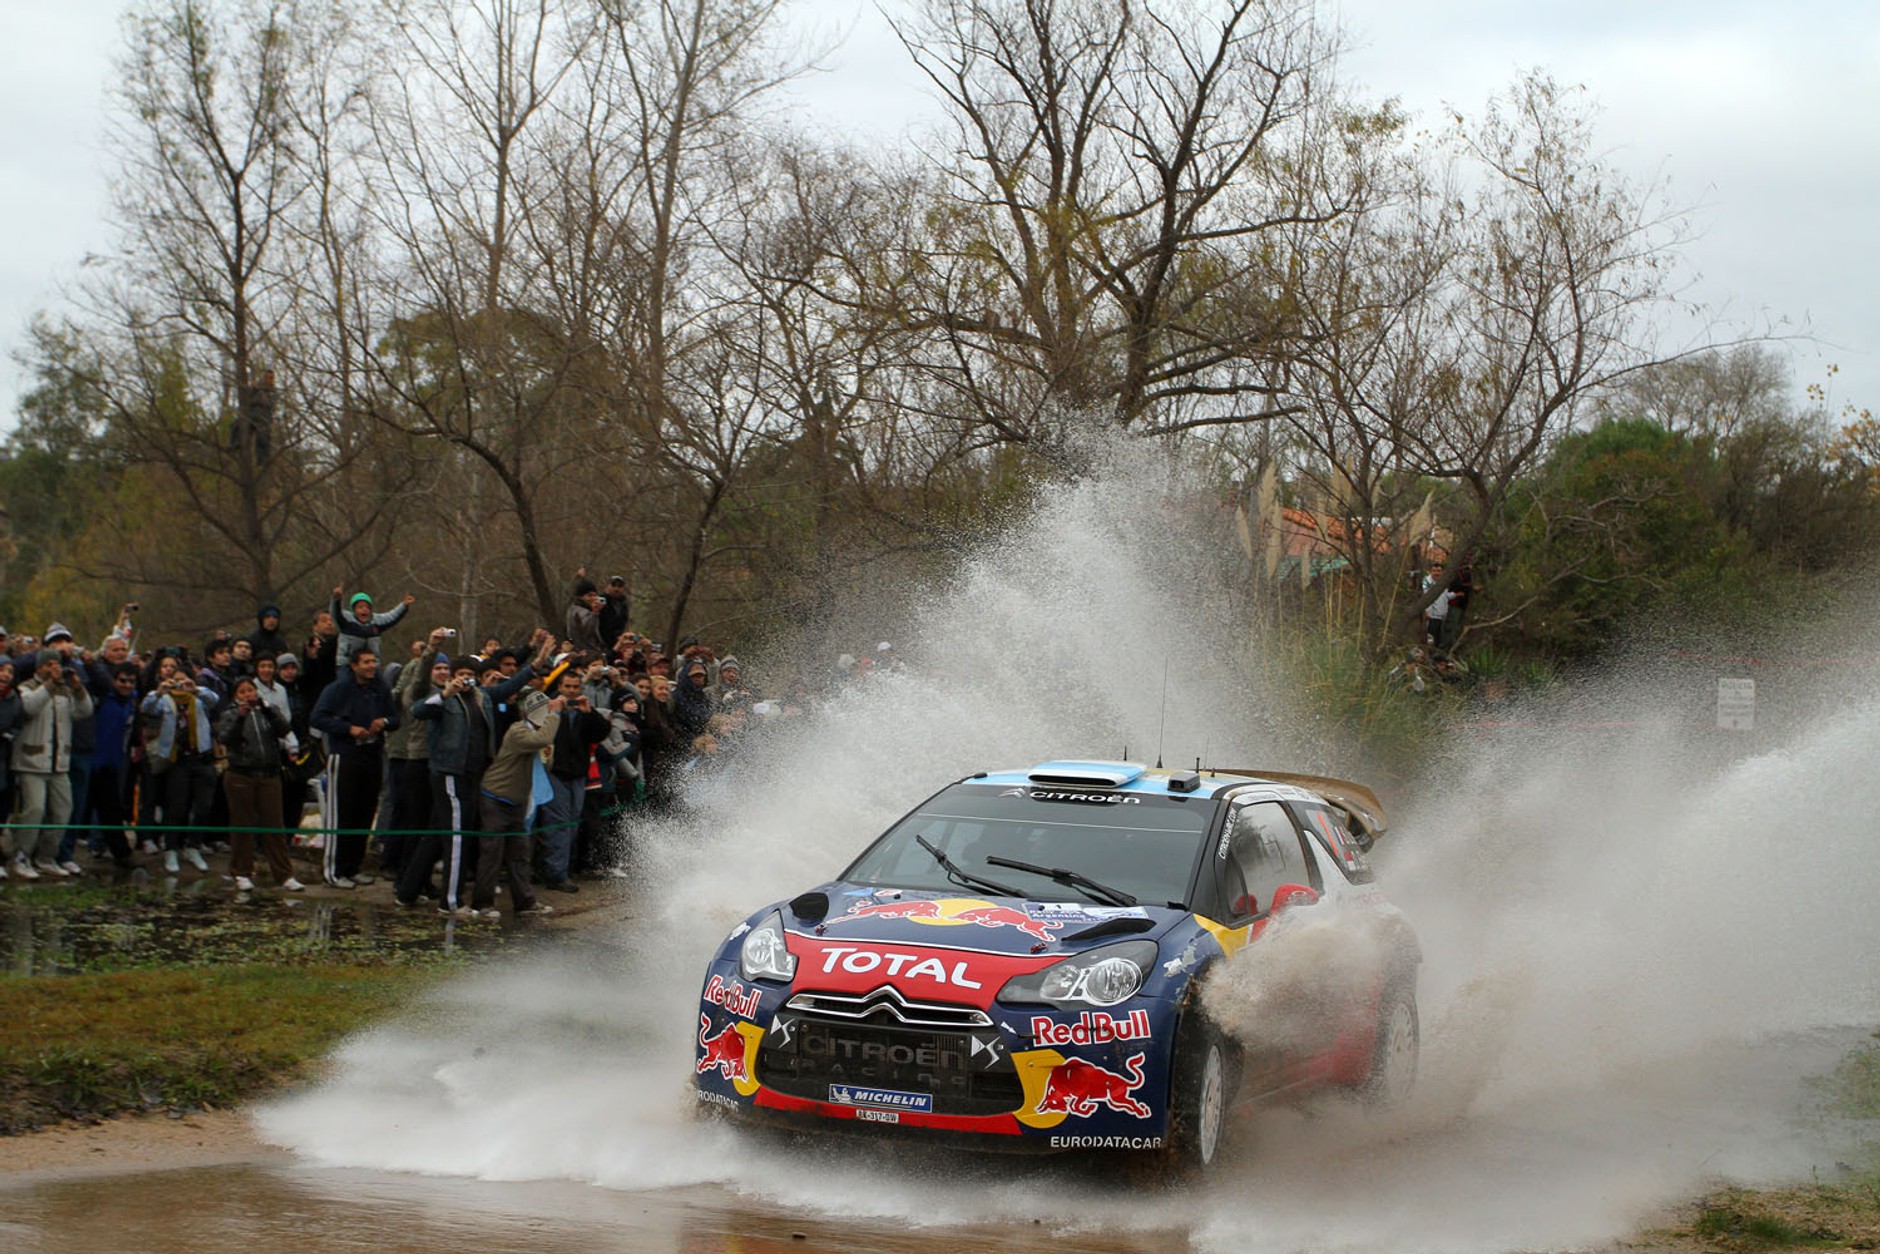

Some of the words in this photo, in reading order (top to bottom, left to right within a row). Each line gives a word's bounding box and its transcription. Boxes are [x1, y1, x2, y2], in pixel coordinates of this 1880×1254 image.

[820, 948, 983, 990] TOTAL
[854, 1091, 927, 1107] MICHELIN
[1050, 1135, 1162, 1149] EURODATACAR
